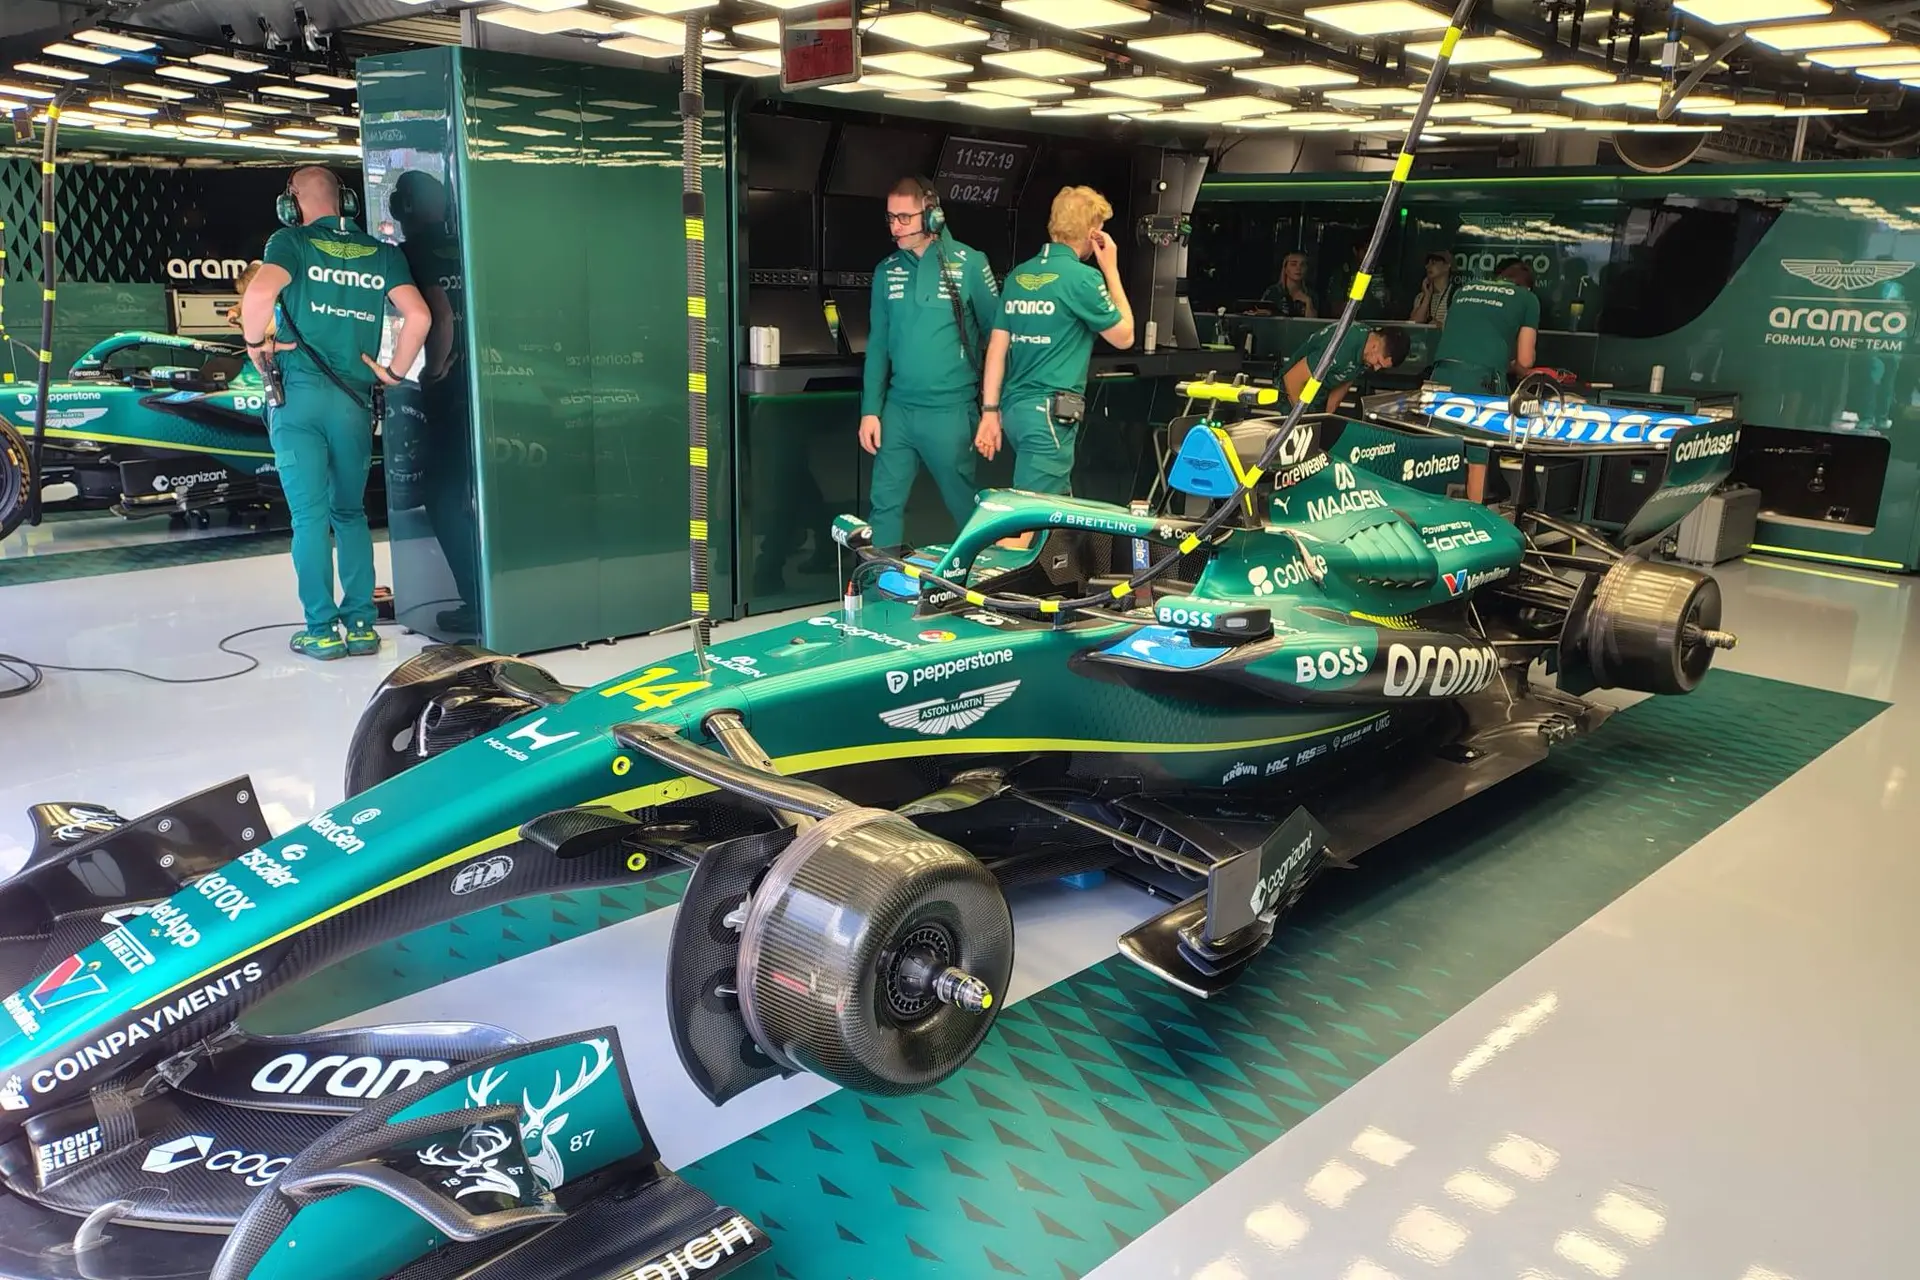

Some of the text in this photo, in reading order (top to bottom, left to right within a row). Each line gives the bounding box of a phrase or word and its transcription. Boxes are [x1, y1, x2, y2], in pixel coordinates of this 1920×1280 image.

[957, 148, 1014, 169] 11:57:19
[950, 184, 999, 202] 0:02:41
[167, 258, 262, 280] aram
[308, 265, 385, 290] aramco
[1816, 266, 1874, 275] ASTON MARTIN
[1769, 307, 1907, 335] aramco
[1764, 333, 1826, 347] FORMULA
[1866, 339, 1902, 352] TEAM
[36, 392, 101, 403] pperstone
[233, 396, 265, 410] BO
[1360, 442, 1396, 460] cognizant
[1675, 431, 1734, 463] coinbase
[171, 468, 227, 487] cognizant
[1274, 452, 1329, 491] CoreWeave
[1415, 453, 1460, 479] cohere
[1306, 489, 1388, 523] MAADEN
[1066, 514, 1137, 533] BREITLING
[1422, 520, 1472, 535] Powered by
[1273, 553, 1328, 588] cohe
[1159, 607, 1213, 628] BOSS
[913, 648, 1013, 687] pepperstone
[1296, 645, 1368, 683] BOSS
[598, 667, 713, 712] 14
[921, 696, 982, 720] ASTON MARTIN
[483, 737, 528, 761] Honda
[1222, 763, 1258, 785] KROWN
[1267, 830, 1312, 893] cognizant
[31, 962, 262, 1094] COINPAYMENTS
[39, 1126, 99, 1158] EIGHT
[570, 1129, 596, 1152] 87
[41, 1141, 102, 1172] SLEEP
[441, 1177, 461, 1188] 18
